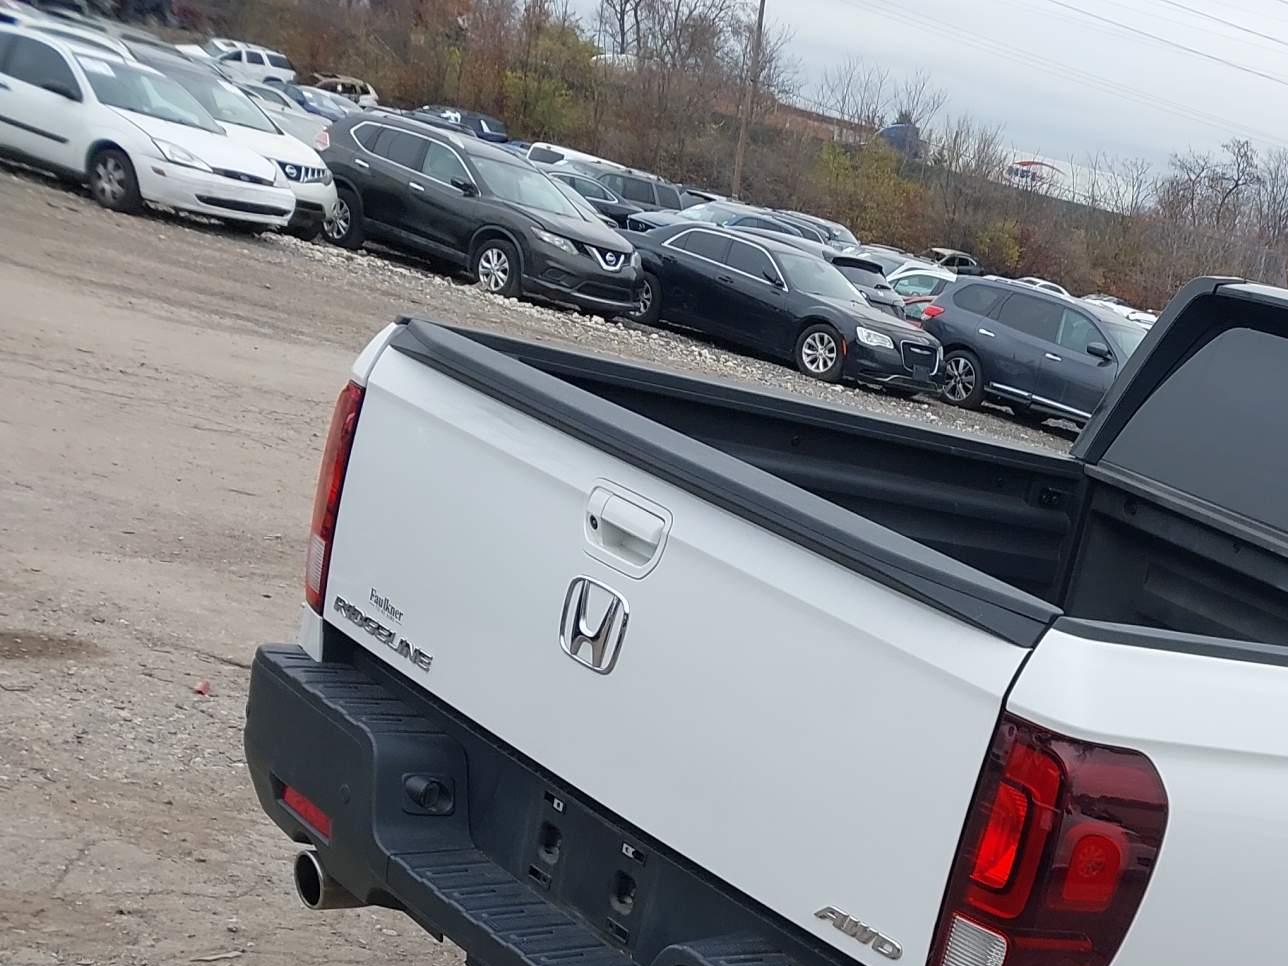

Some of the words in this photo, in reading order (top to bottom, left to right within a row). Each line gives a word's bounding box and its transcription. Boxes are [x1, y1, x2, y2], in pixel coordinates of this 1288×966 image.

[369, 587, 404, 621] Faulkner
[333, 594, 434, 673] RIDGELINE
[813, 904, 904, 961] AWD
